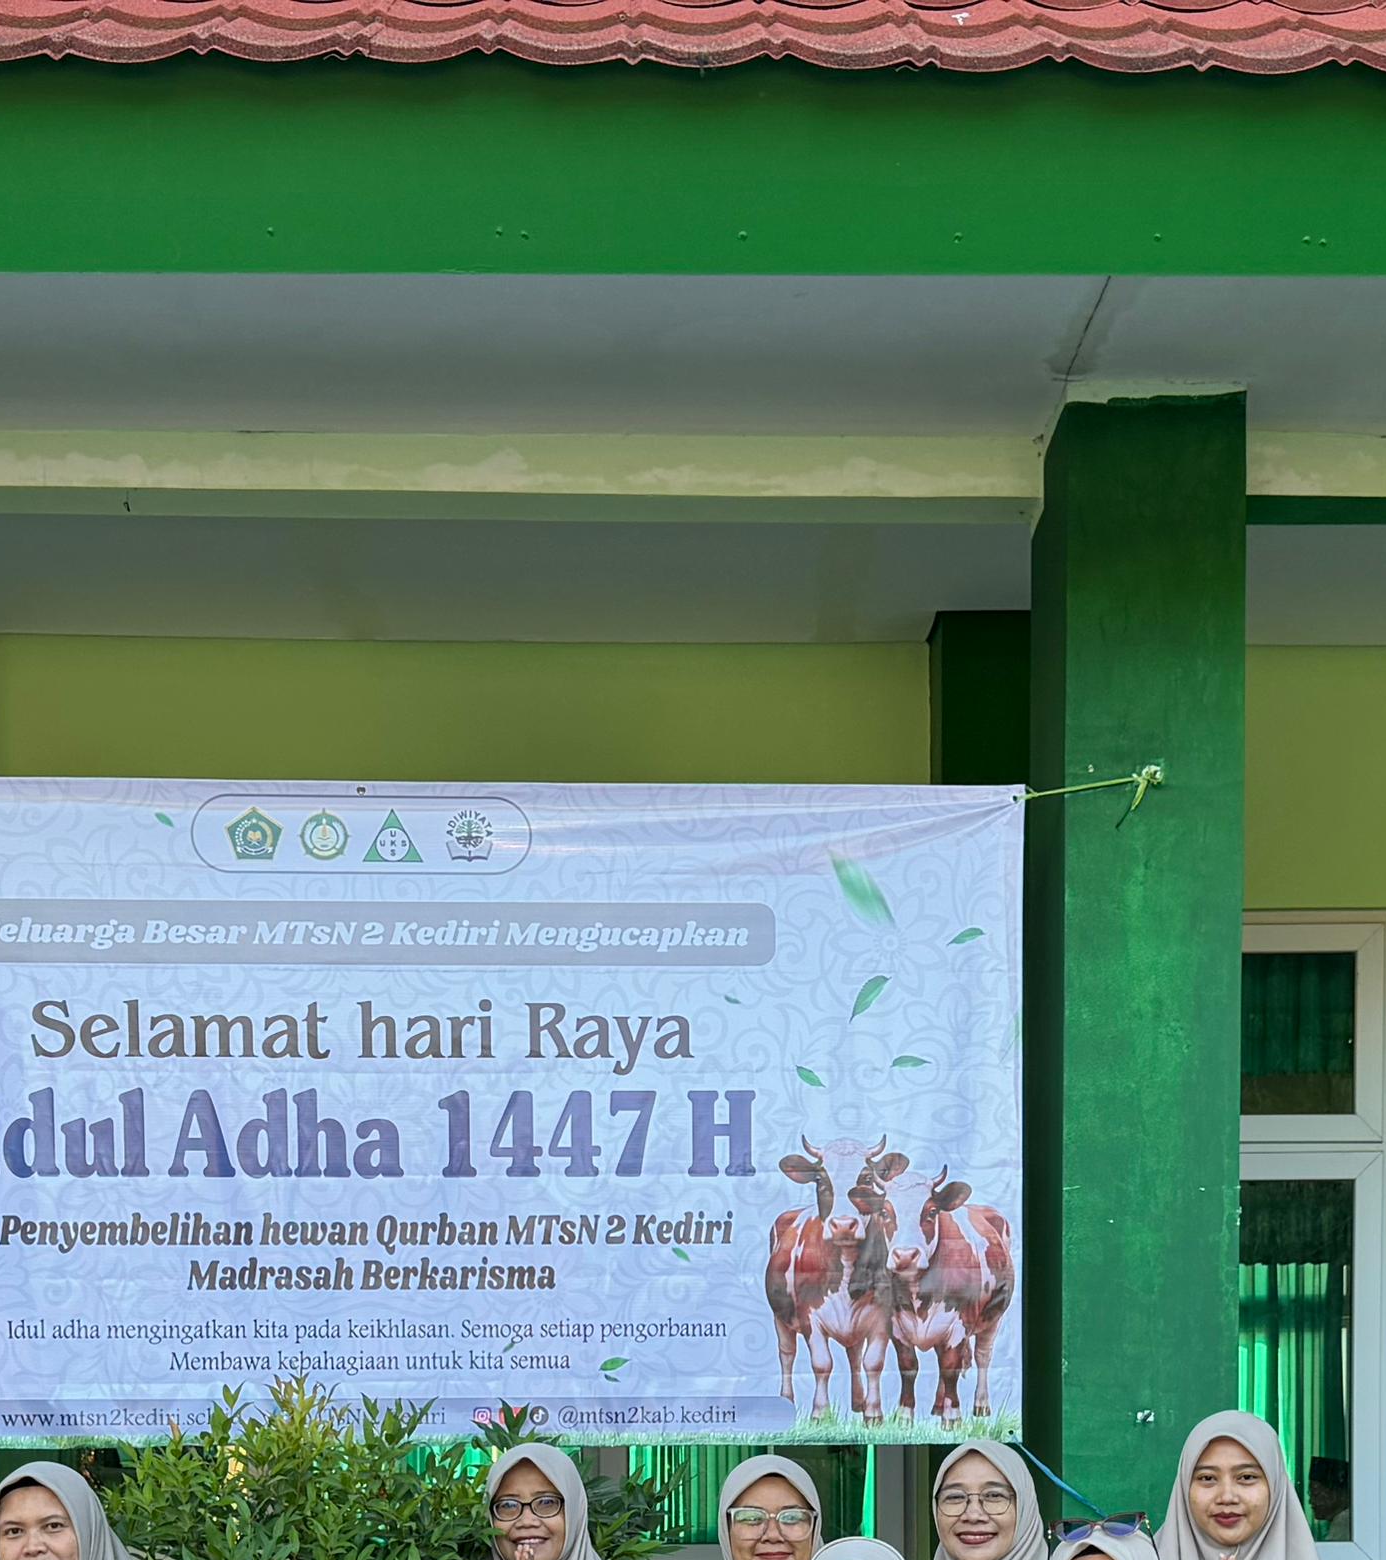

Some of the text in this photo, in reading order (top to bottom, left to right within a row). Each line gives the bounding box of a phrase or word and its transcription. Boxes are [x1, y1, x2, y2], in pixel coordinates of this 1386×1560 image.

[446, 810, 493, 837] ADIWIYATA
[142, 919, 247, 945] Besar
[253, 920, 357, 946] MTsN
[361, 922, 384, 946] 2
[390, 919, 501, 946] Kediri
[505, 920, 749, 952] Mengucapkan
[30, 998, 695, 1075] Selamat hari Raya
[168, 1087, 404, 1178] Adha
[437, 1089, 657, 1177] 1447
[687, 1090, 757, 1177] H
[260, 1212, 368, 1246] hewan
[376, 1212, 498, 1255] Qurban
[505, 1214, 601, 1246] MTsN
[605, 1215, 626, 1245] 2
[632, 1211, 734, 1246] Kediri
[187, 1256, 556, 1291] Madrasah Berkarisma
[7, 1318, 727, 1344] Idul adha mengingatkan kita pada keikhlasan. Semoga setiap pengorbanan
[169, 1350, 571, 1376] Membawa kebahagiaan untuk kita semua
[557, 1405, 737, 1426] @mtsn2kab.kediri
